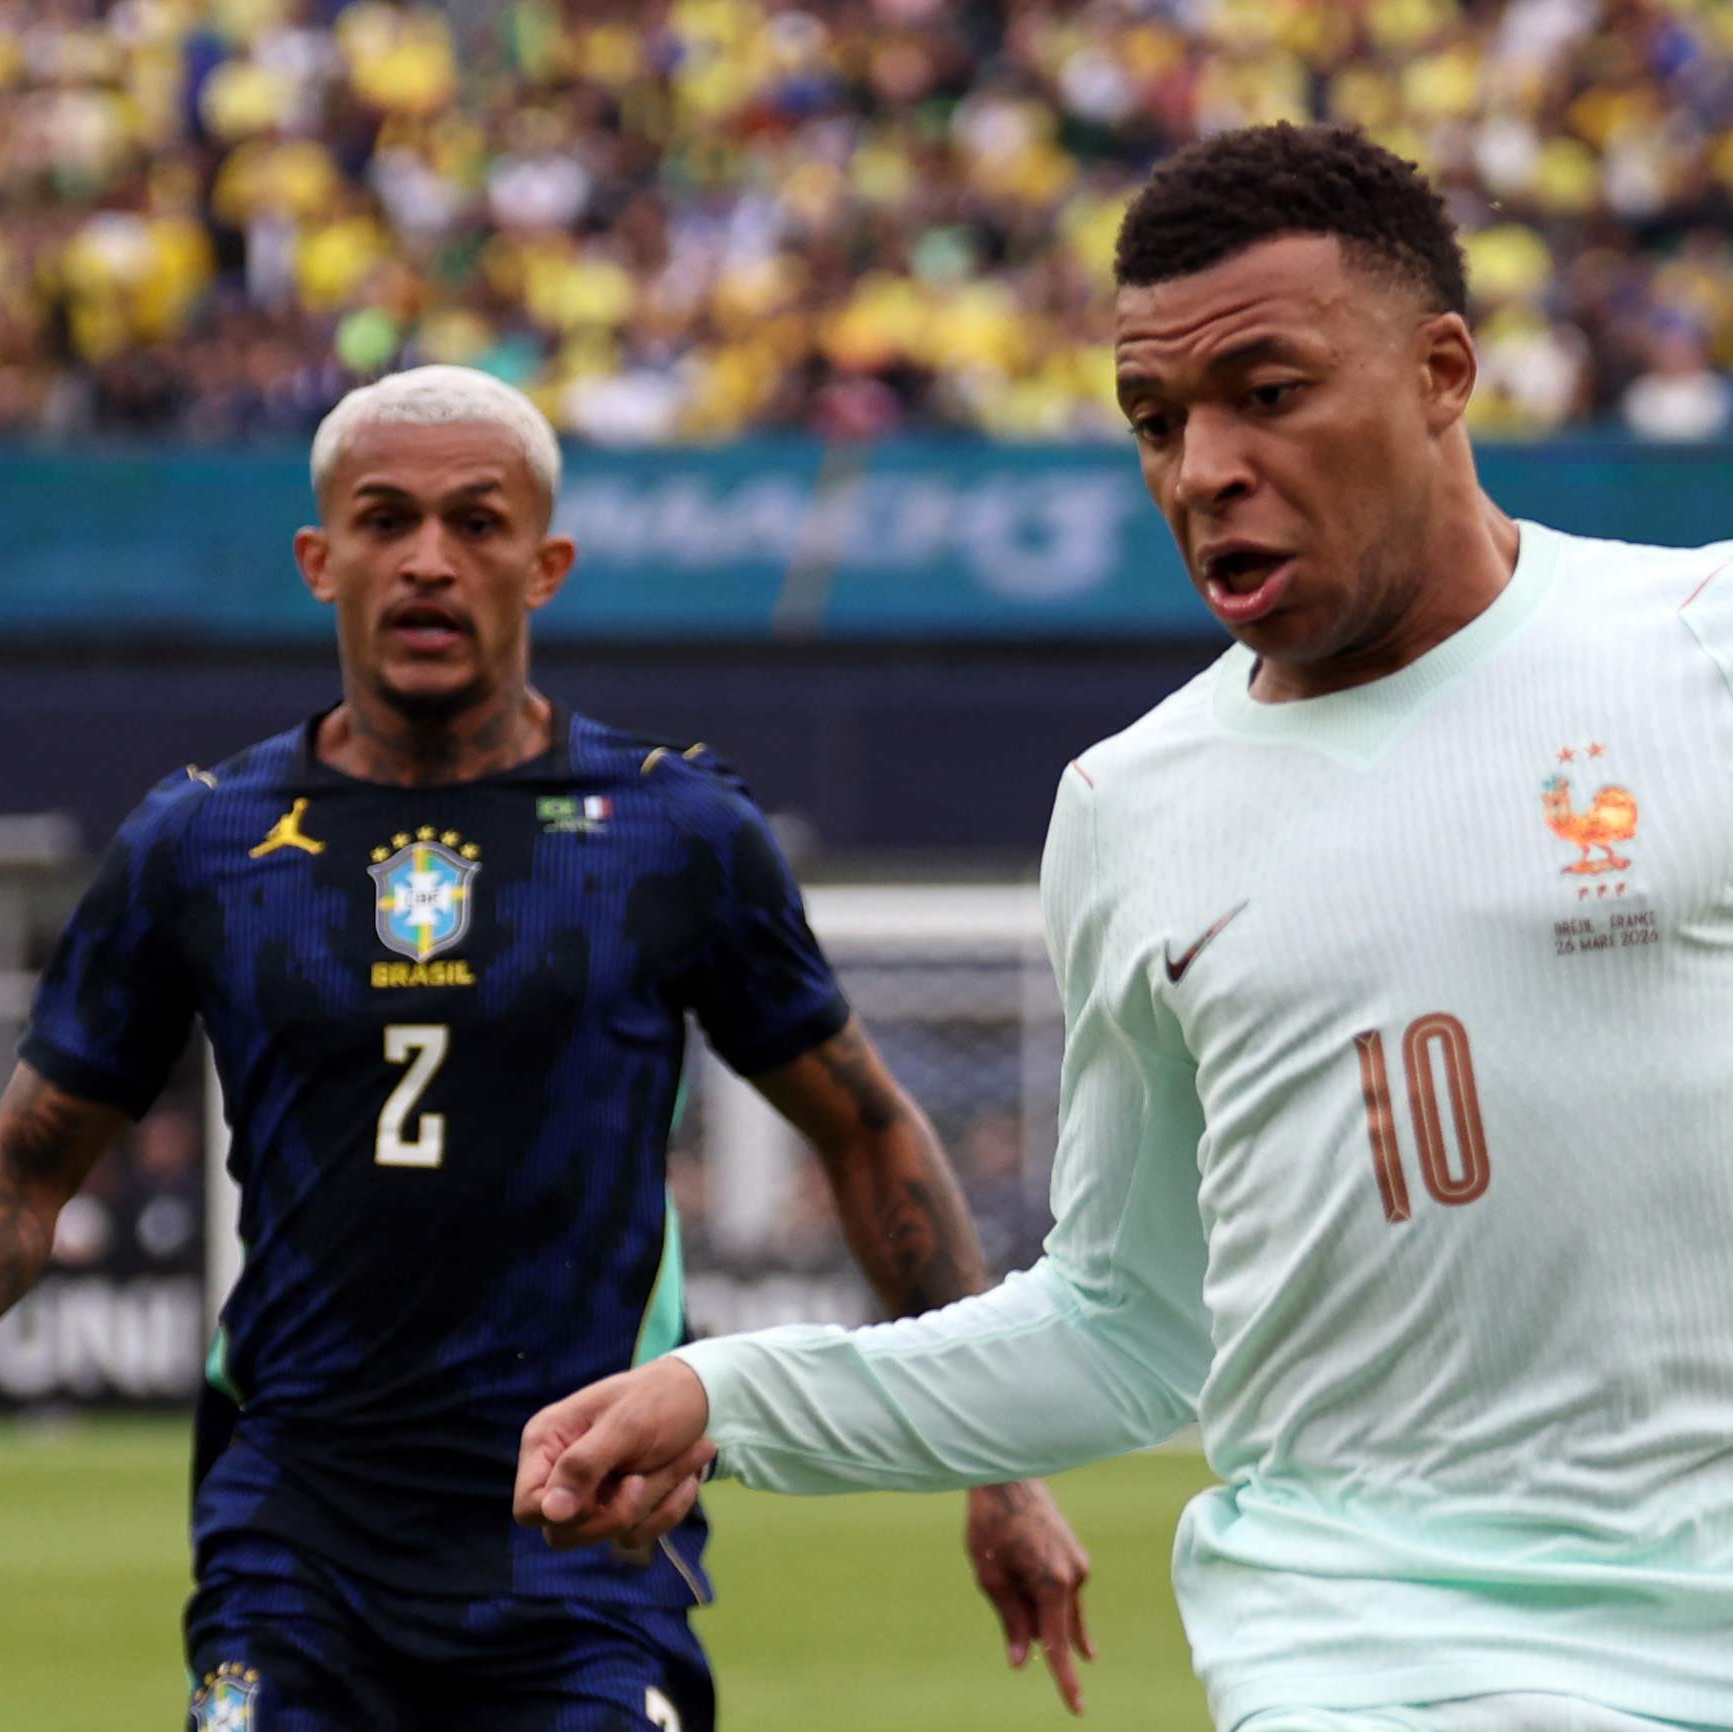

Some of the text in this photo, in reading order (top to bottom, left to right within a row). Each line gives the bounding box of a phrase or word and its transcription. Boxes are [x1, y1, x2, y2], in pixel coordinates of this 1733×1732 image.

[1610, 911, 1656, 929] FRANCE
[1556, 929, 1659, 956] 26 MARS 2026
[371, 960, 476, 989] BRASIL
[375, 1023, 450, 1168] 2
[1354, 1011, 1492, 1224] 10
